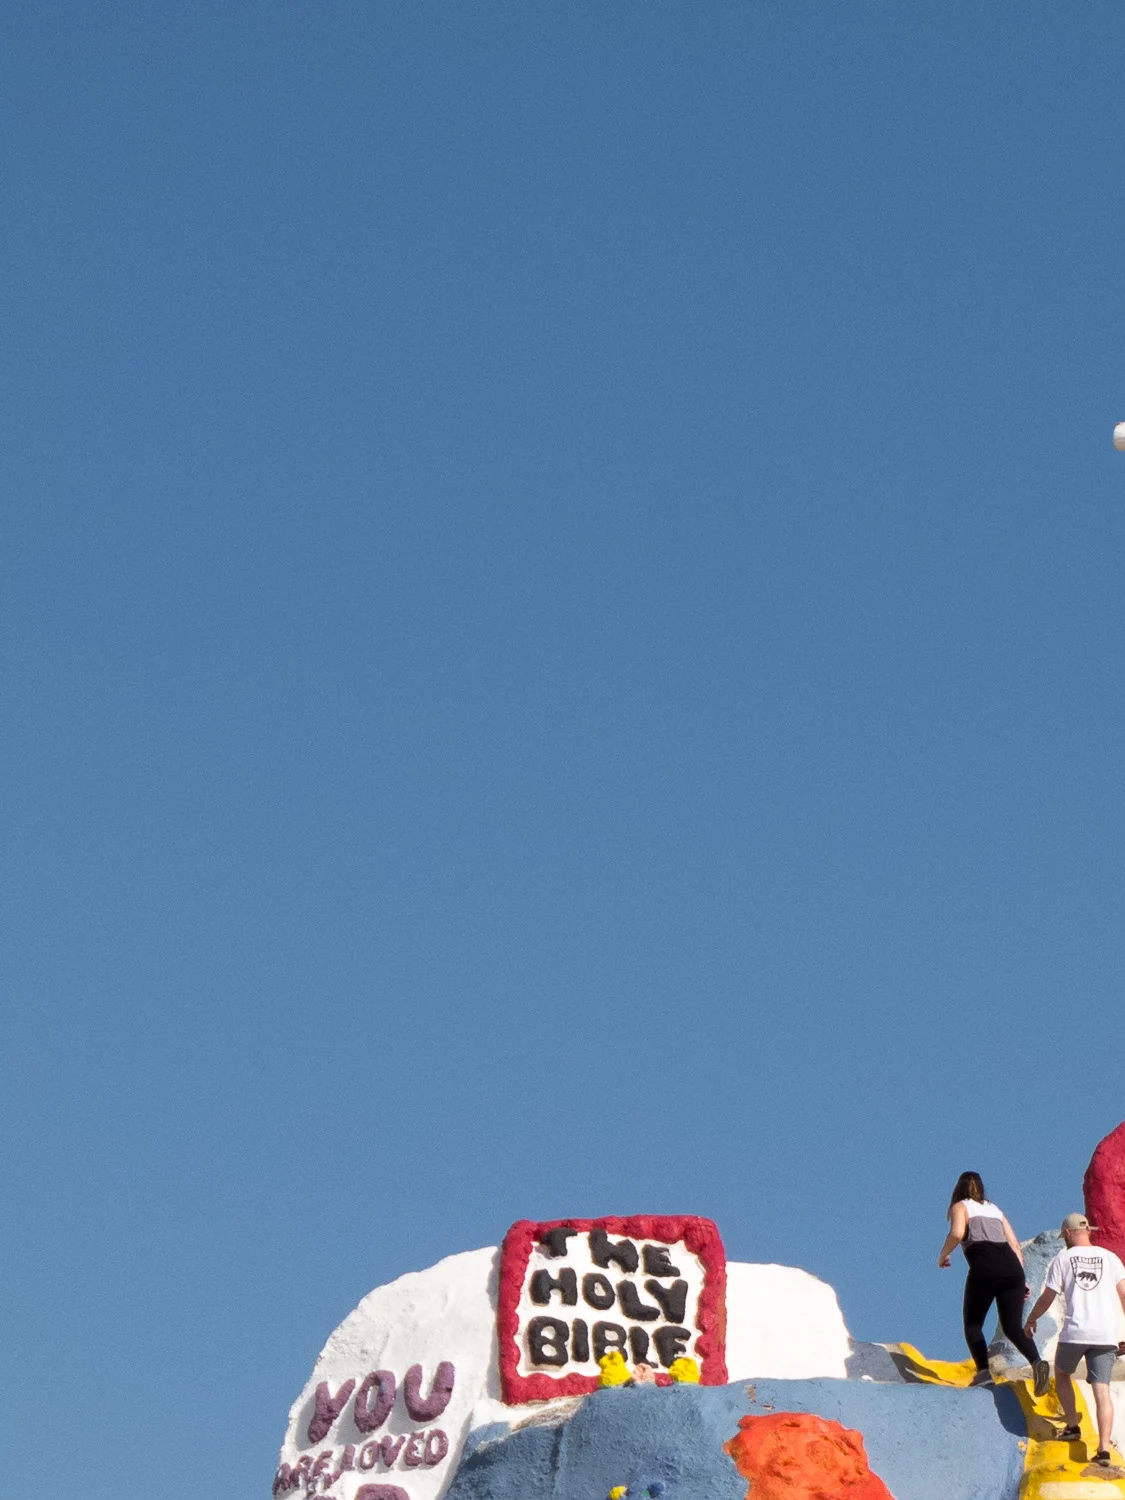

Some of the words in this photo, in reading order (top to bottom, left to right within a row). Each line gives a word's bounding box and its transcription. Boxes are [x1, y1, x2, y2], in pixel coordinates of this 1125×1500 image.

[540, 1227, 681, 1277] THE
[528, 1267, 689, 1333] HOLY
[528, 1316, 691, 1368] BIBLE
[307, 1361, 454, 1444] YOU
[340, 1428, 449, 1471] LOVED
